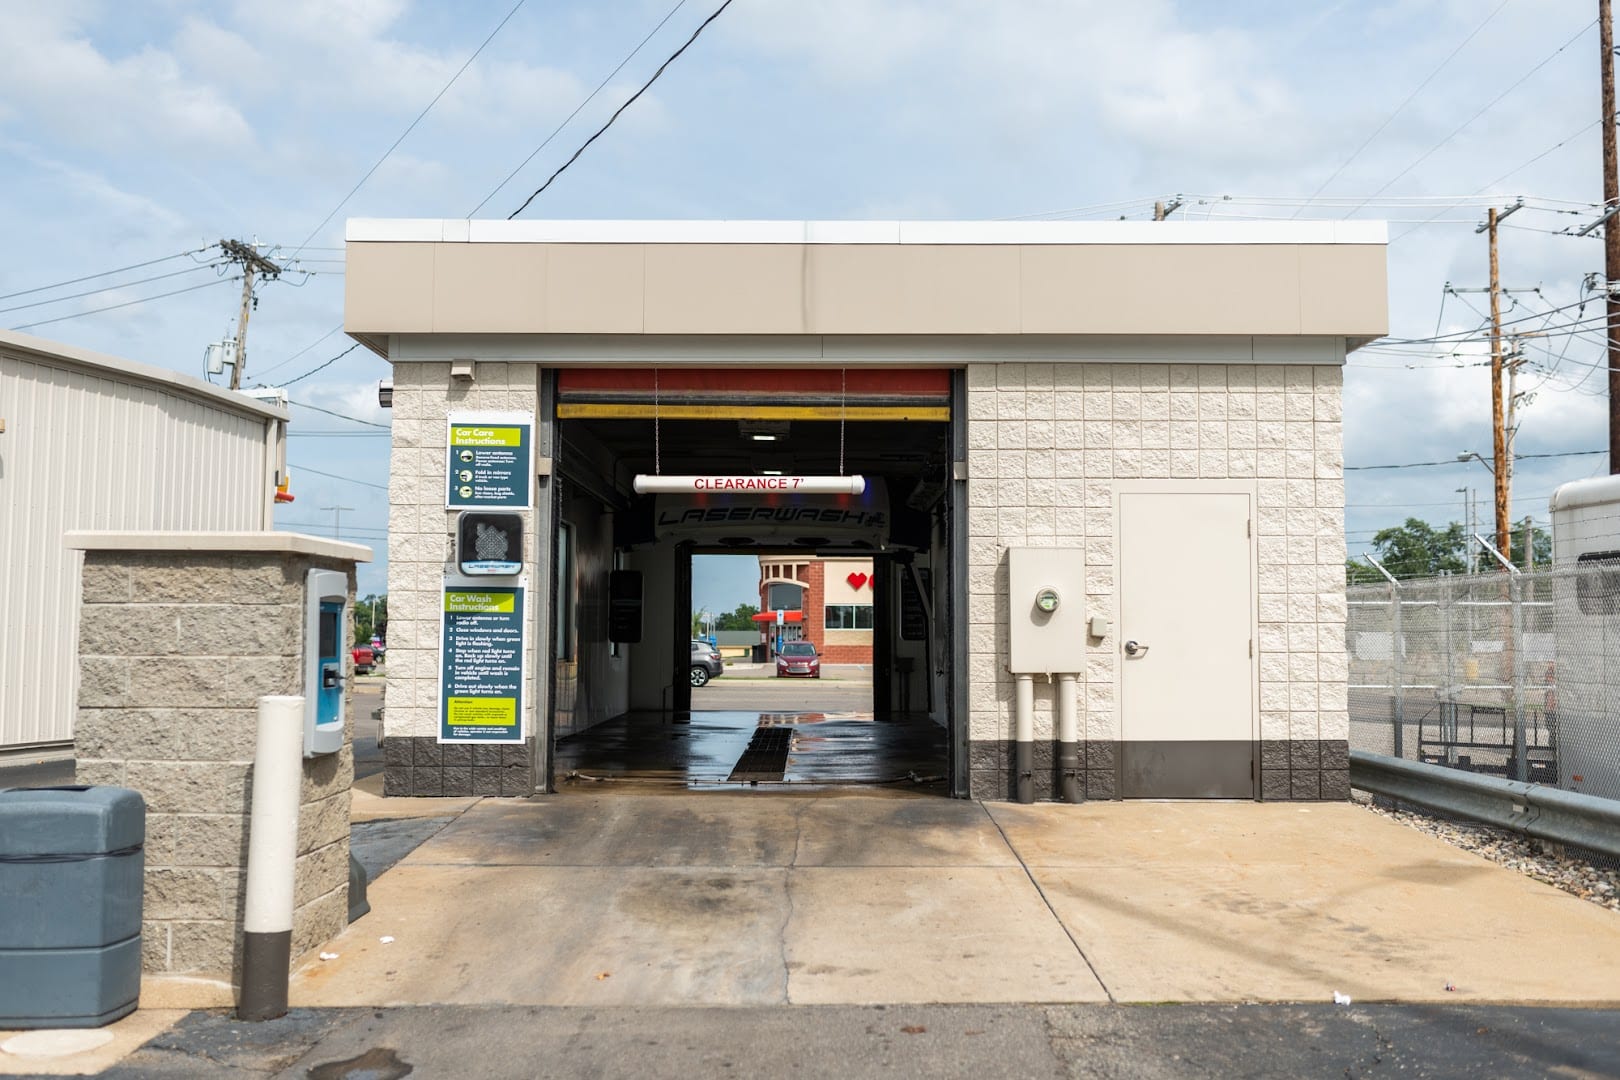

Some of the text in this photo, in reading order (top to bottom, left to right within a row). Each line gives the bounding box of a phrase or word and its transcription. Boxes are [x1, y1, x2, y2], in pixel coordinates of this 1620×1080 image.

[456, 437, 506, 445] Instructions
[694, 478, 804, 489] CLEARANCE 7'
[658, 507, 865, 526] LASERWASH
